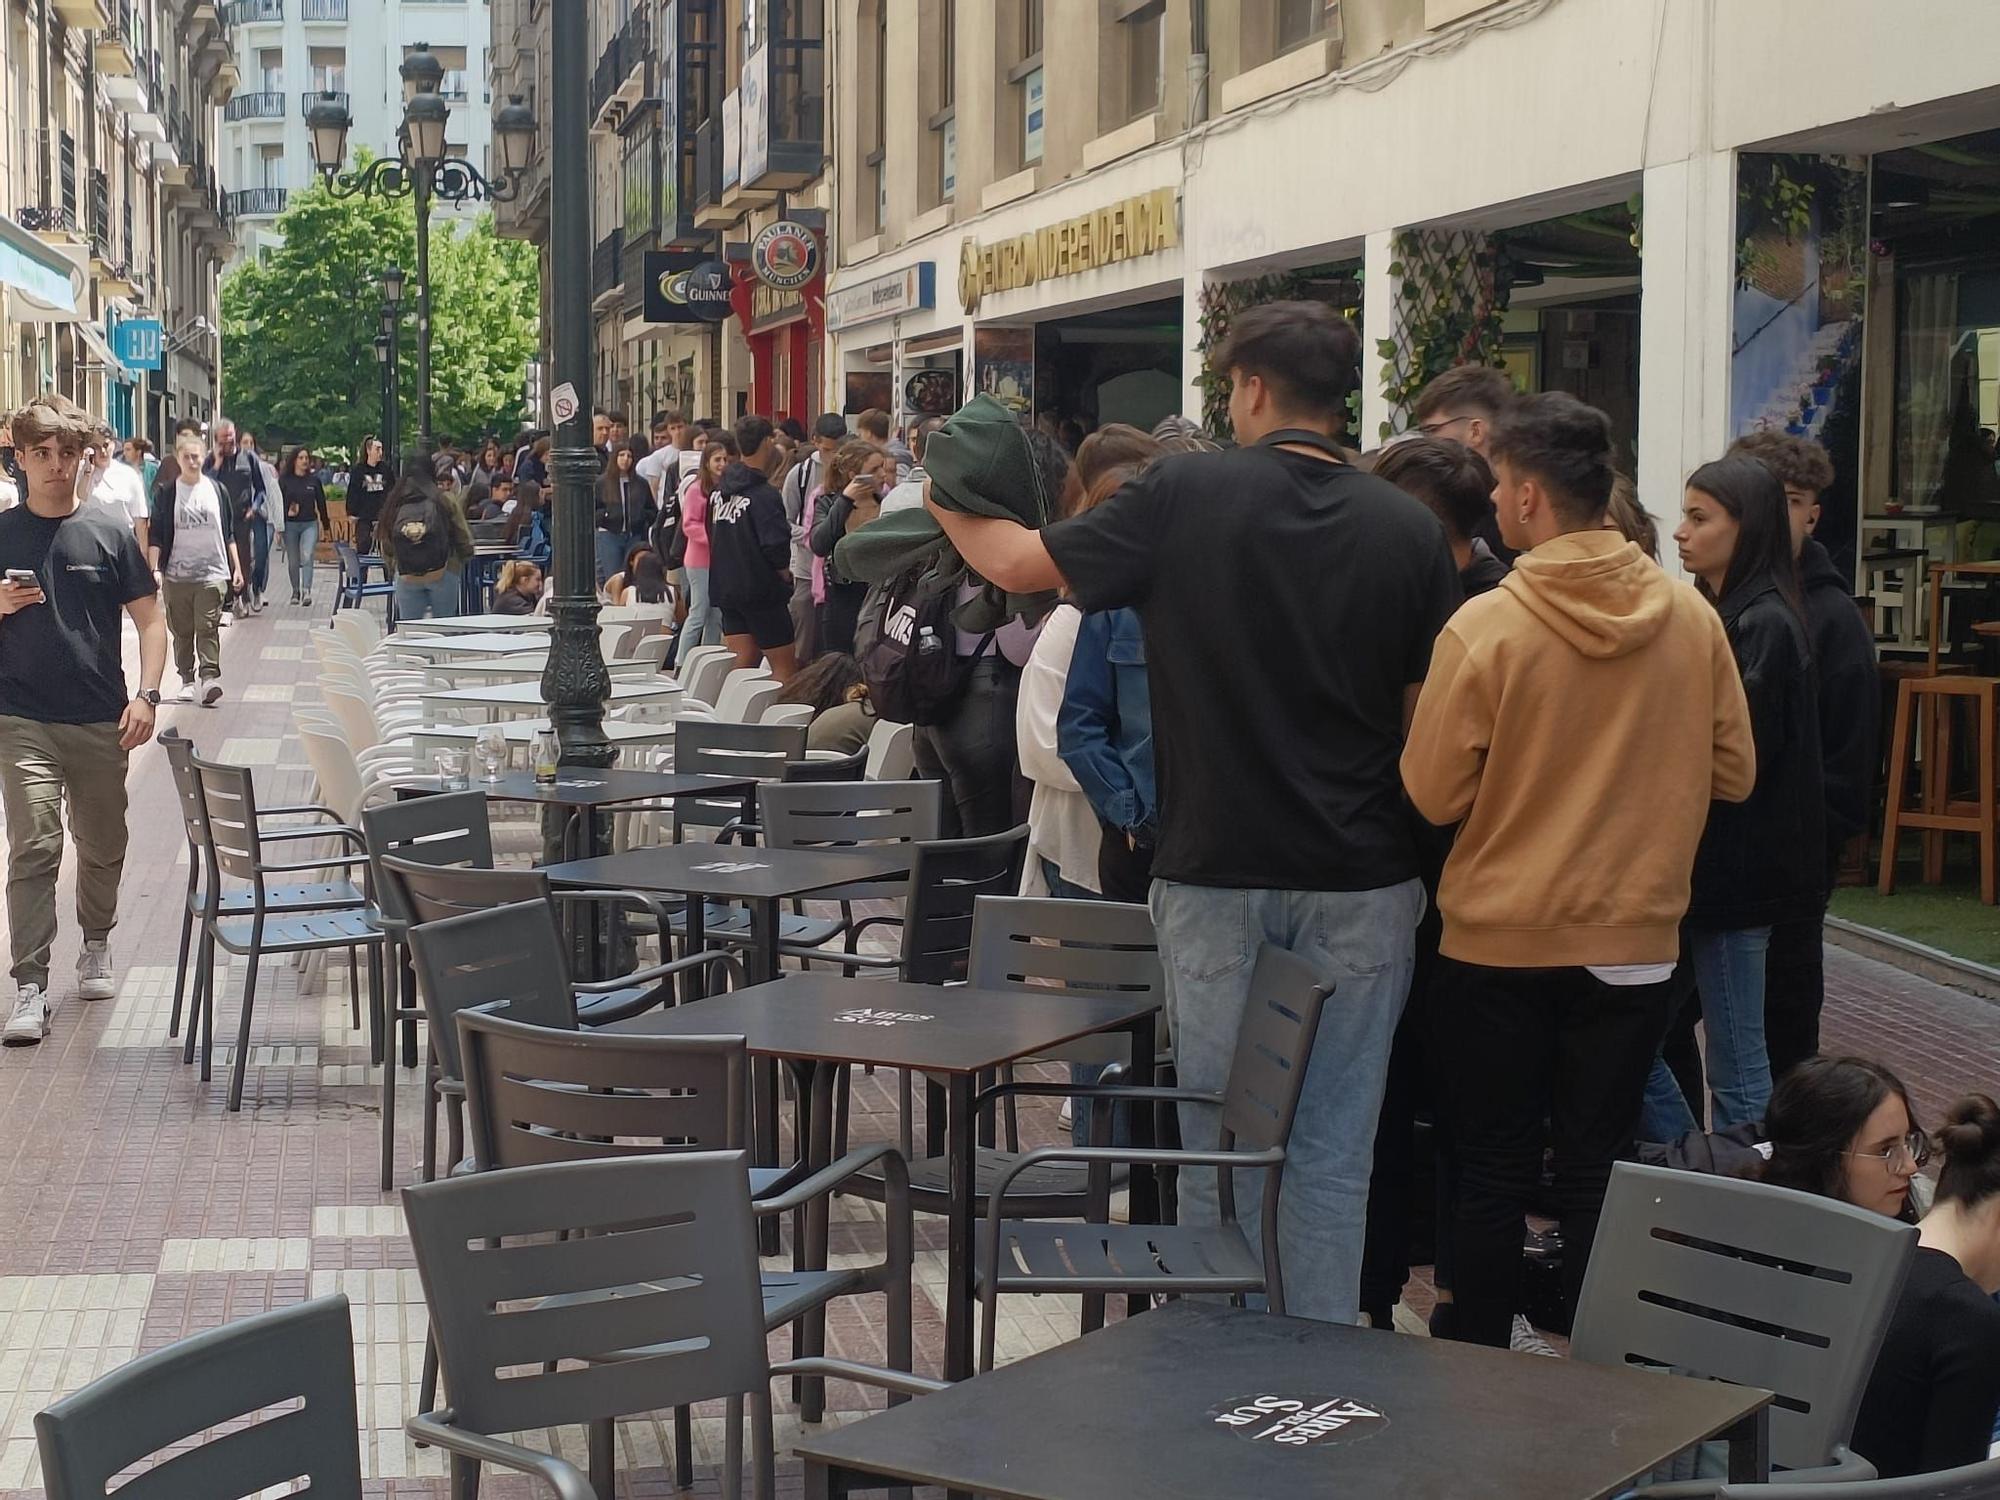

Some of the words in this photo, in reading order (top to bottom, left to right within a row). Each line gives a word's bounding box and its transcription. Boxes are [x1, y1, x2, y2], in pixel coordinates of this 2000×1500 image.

[758, 225, 815, 250] PAULANER
[1036, 186, 1177, 282] INDEPENDENCIA
[689, 288, 731, 301] GUINNE
[1214, 1396, 1304, 1426] SUR
[1274, 1401, 1382, 1445] AIRES
